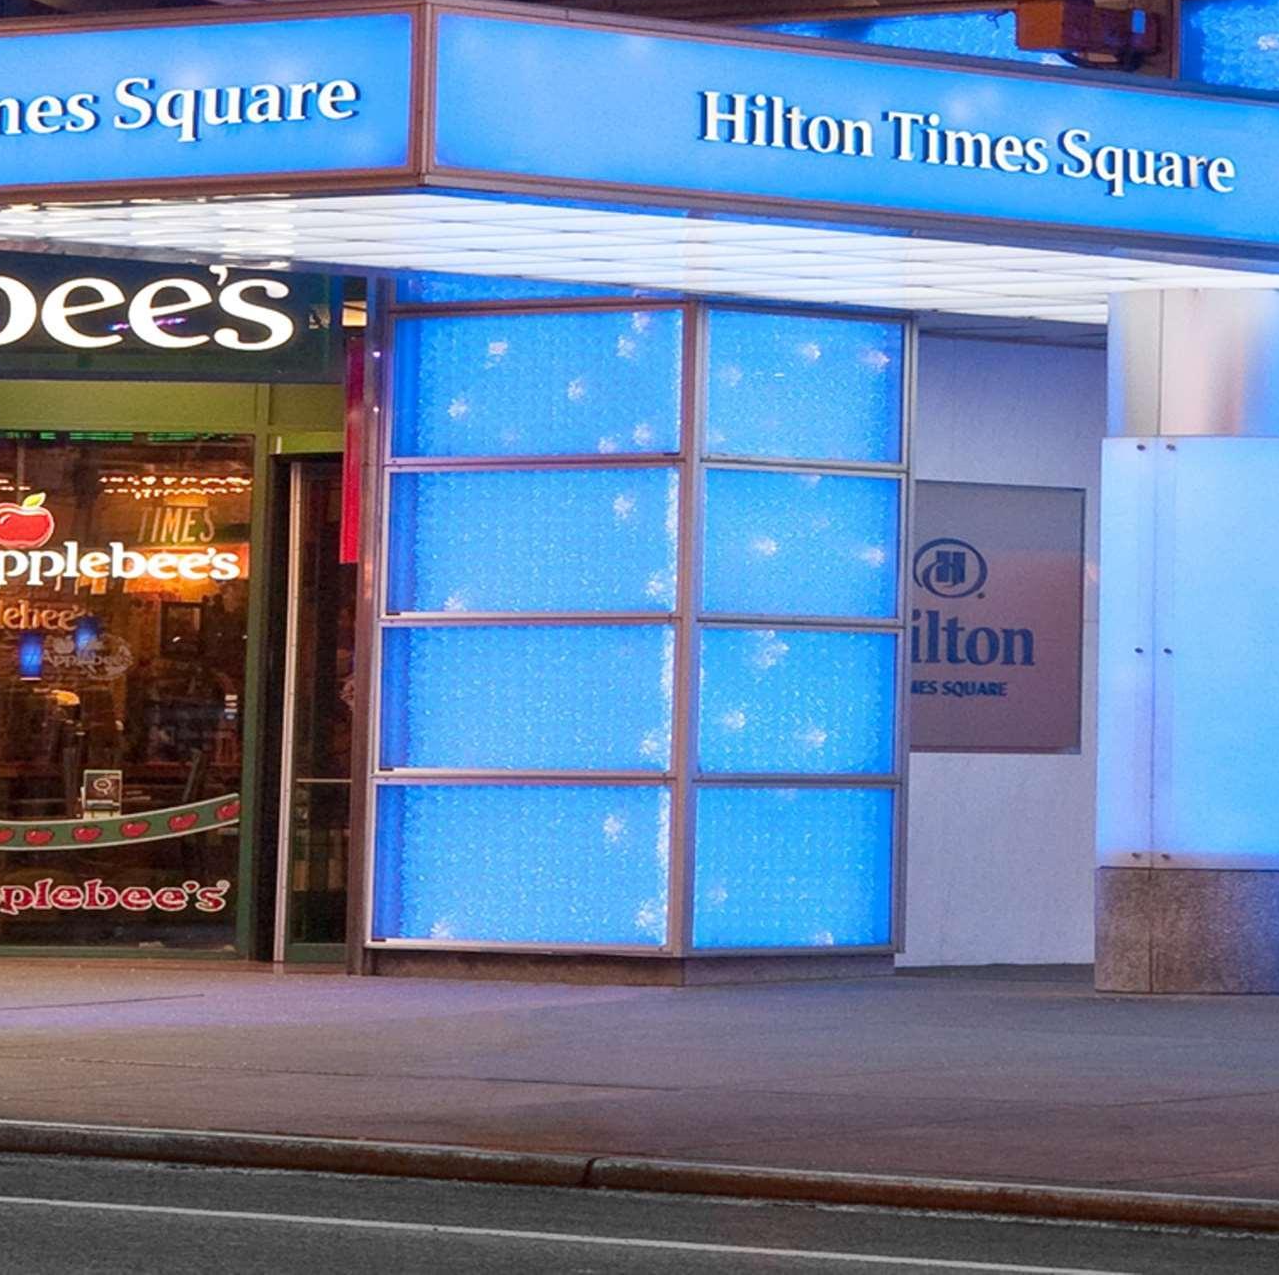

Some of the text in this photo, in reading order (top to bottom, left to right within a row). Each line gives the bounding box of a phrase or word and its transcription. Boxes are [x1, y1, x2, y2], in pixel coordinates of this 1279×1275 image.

[114, 77, 361, 142] Square
[701, 91, 1236, 196] Hilton Times Square
[942, 680, 1008, 697] SQUARE
